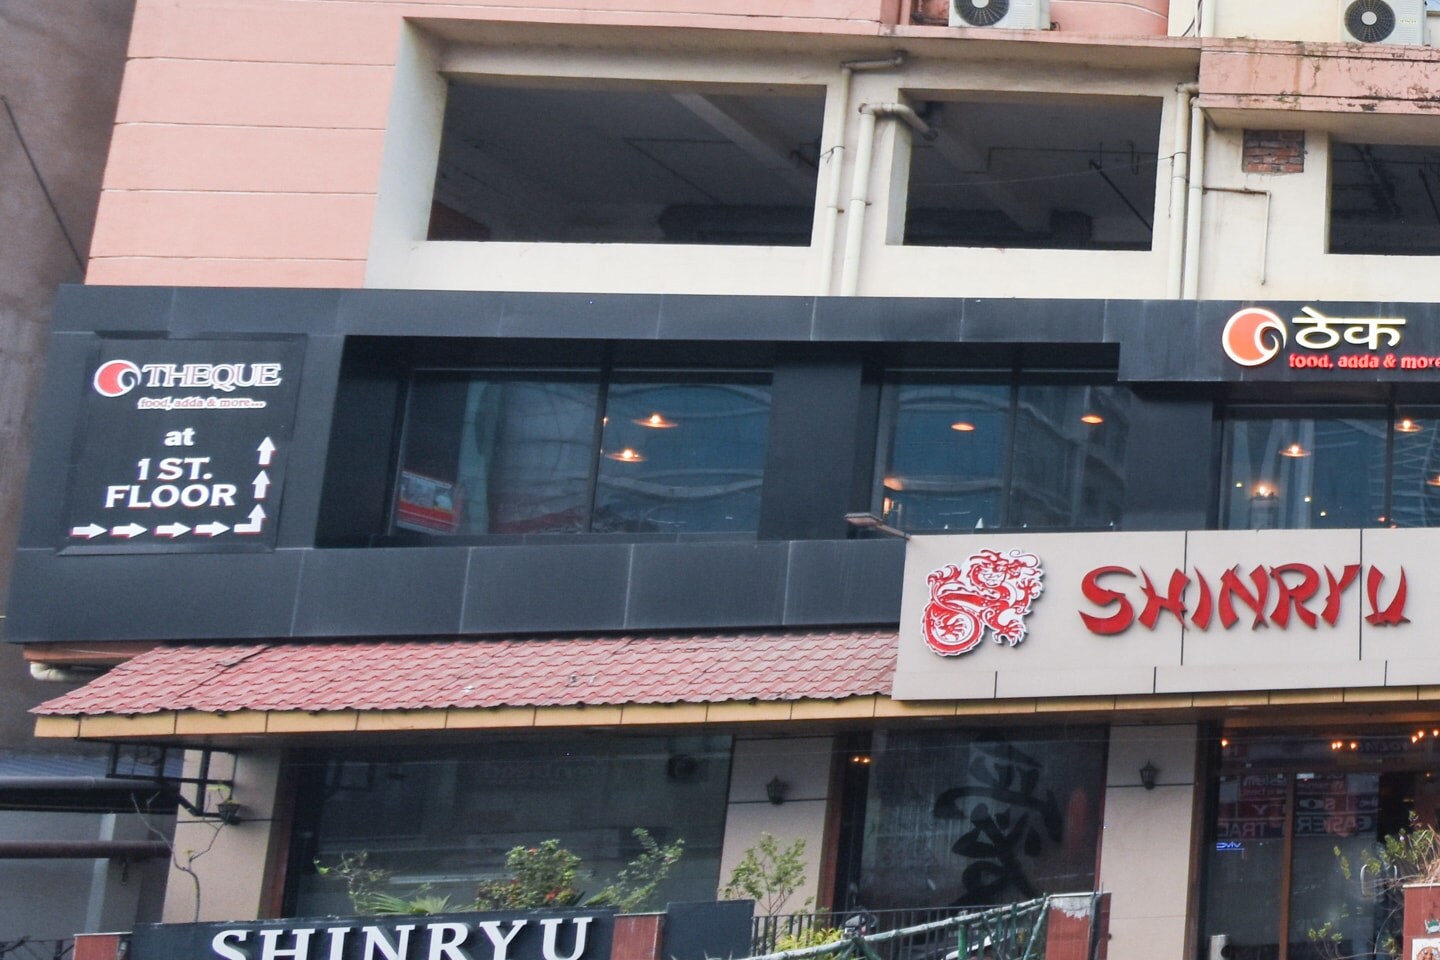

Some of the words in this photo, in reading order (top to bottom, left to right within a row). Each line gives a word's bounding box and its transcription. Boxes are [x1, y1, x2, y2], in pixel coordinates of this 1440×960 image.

[1292, 306, 1406, 350] ठेक
[1289, 353, 1334, 370] food,
[1338, 353, 1380, 369] adda
[1383, 353, 1396, 369] &
[142, 363, 282, 392] THEQUE
[137, 396, 171, 410] food,
[173, 396, 204, 409] adda
[205, 397, 216, 409] &
[164, 427, 195, 446] at
[105, 484, 237, 507] FLOOR
[1079, 562, 1411, 635] SHINRYU
[211, 917, 594, 960] SHINRYU
